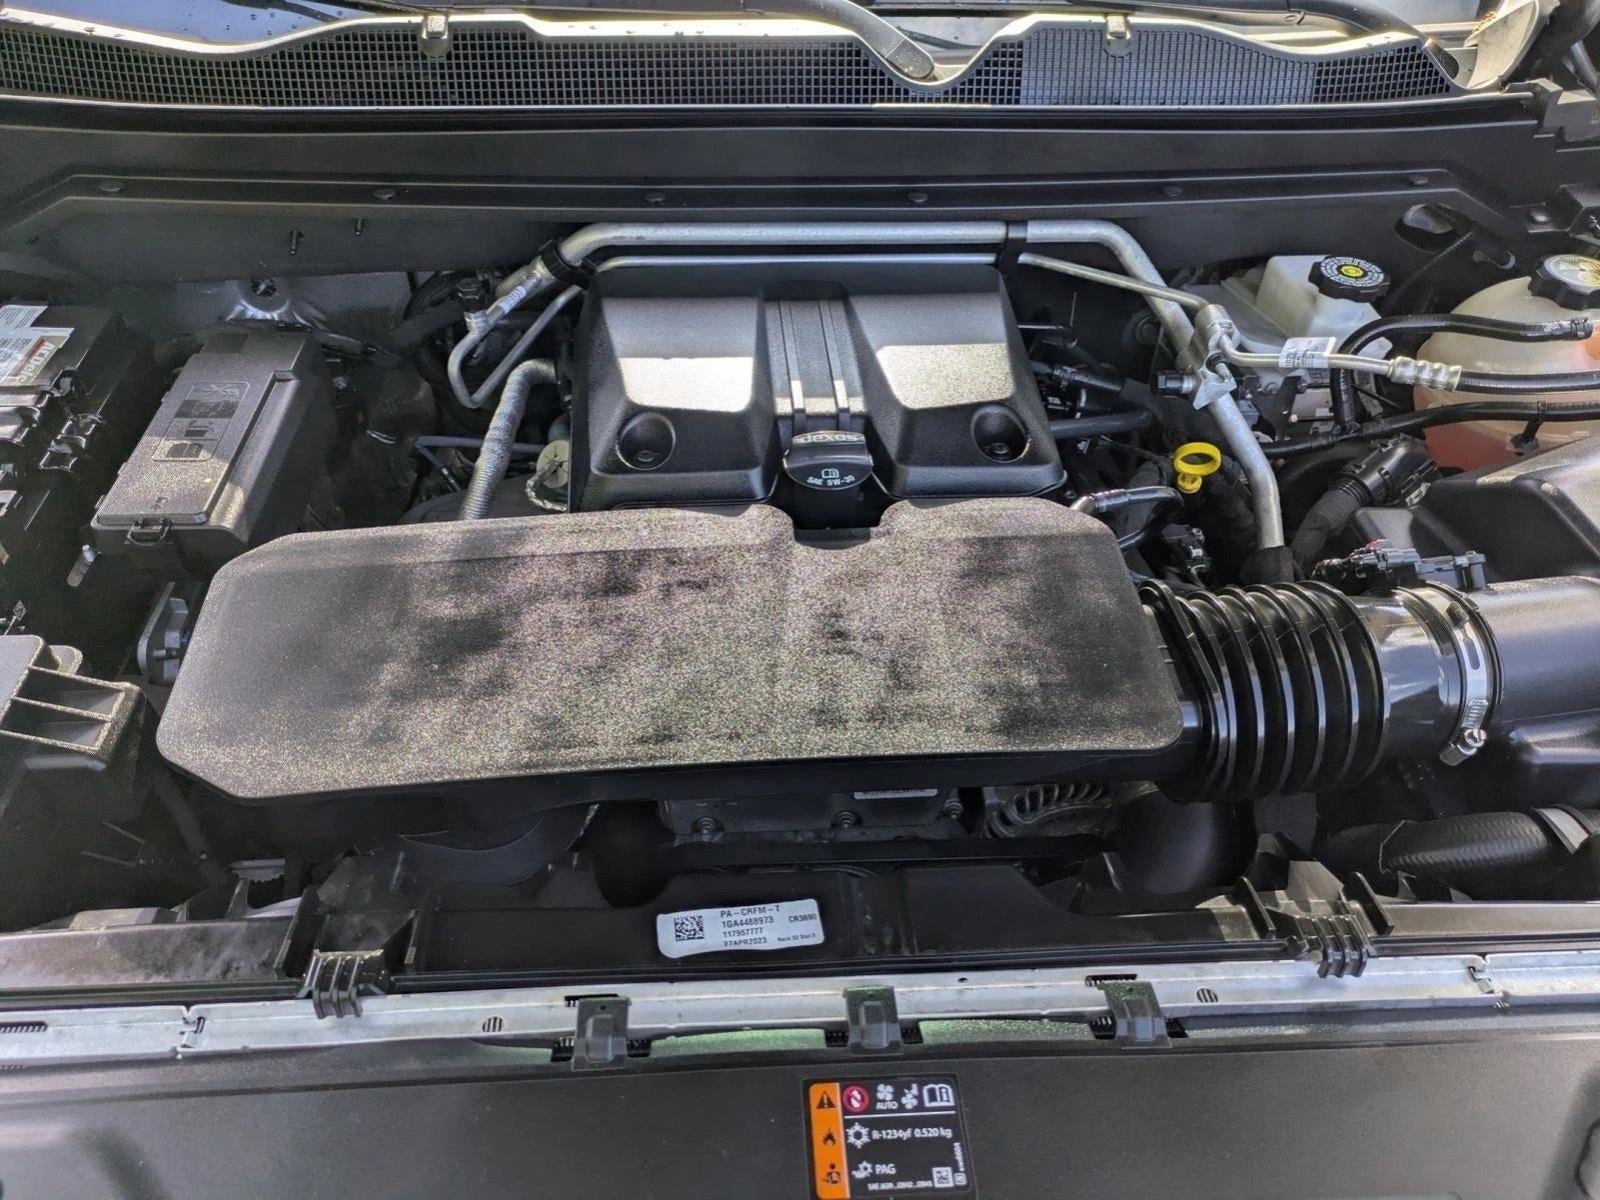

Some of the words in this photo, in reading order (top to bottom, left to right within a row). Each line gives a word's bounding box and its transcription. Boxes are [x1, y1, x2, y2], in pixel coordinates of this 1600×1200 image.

[806, 476, 824, 486] SAE
[826, 474, 856, 486] 5W-30
[722, 916, 775, 928] 1GA4488973
[875, 1101, 899, 1110] AUTO
[871, 1128, 911, 1140] R-1234yf
[914, 1127, 939, 1138] 0.520
[940, 1127, 953, 1138] kg
[875, 1163, 897, 1175] PAG
